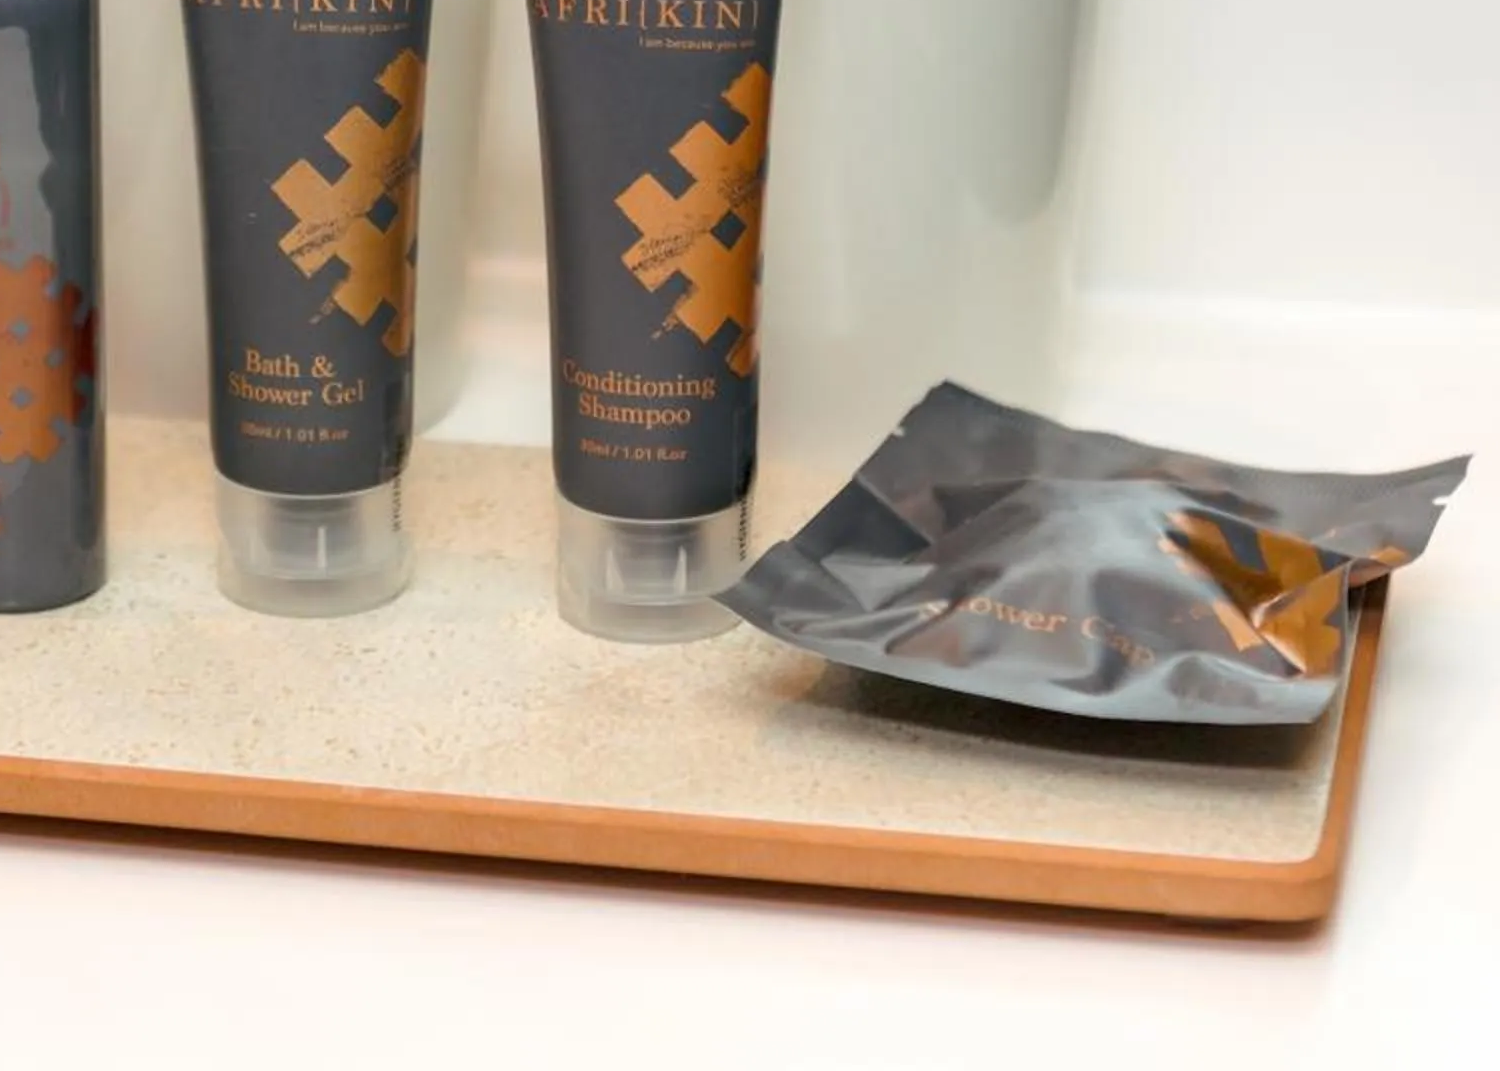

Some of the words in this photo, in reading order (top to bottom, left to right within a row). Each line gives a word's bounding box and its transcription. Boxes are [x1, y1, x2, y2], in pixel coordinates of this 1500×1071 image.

[245, 350, 300, 378] Bath
[311, 355, 337, 379] &
[563, 359, 717, 401] Conditioning
[228, 372, 313, 407] Shower
[322, 379, 365, 406] Gel
[578, 394, 692, 430] Shampoo
